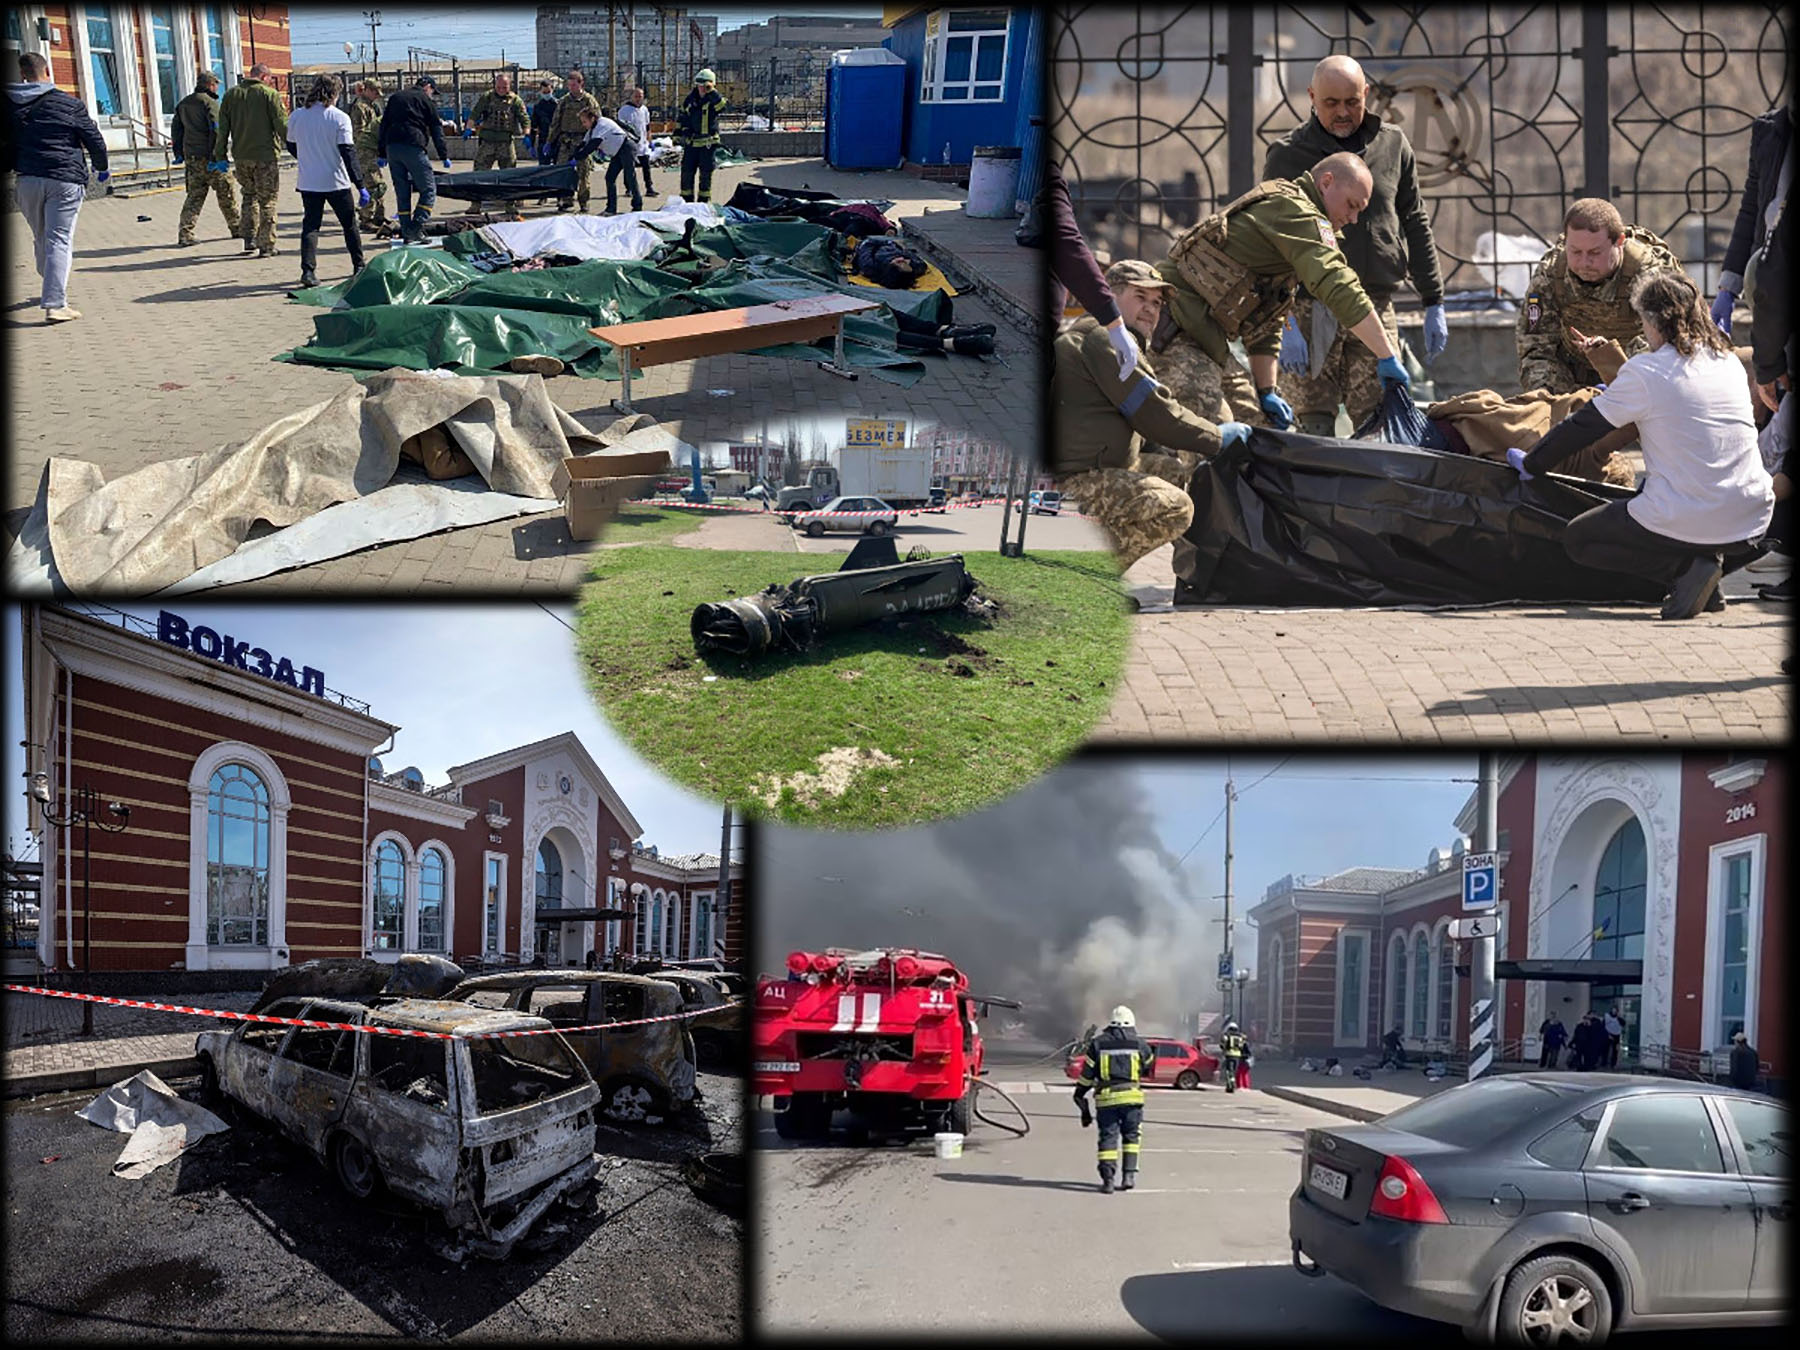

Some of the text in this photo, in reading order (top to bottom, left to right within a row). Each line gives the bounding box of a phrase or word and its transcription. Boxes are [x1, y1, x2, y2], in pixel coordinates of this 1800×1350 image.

[159, 609, 325, 699] ВОКЗАЛ
[1725, 802, 1757, 824] 2014
[1464, 854, 1494, 870] ЗОНА
[1470, 871, 1489, 900] P
[763, 986, 786, 999] АЦ
[929, 990, 944, 1003] 31
